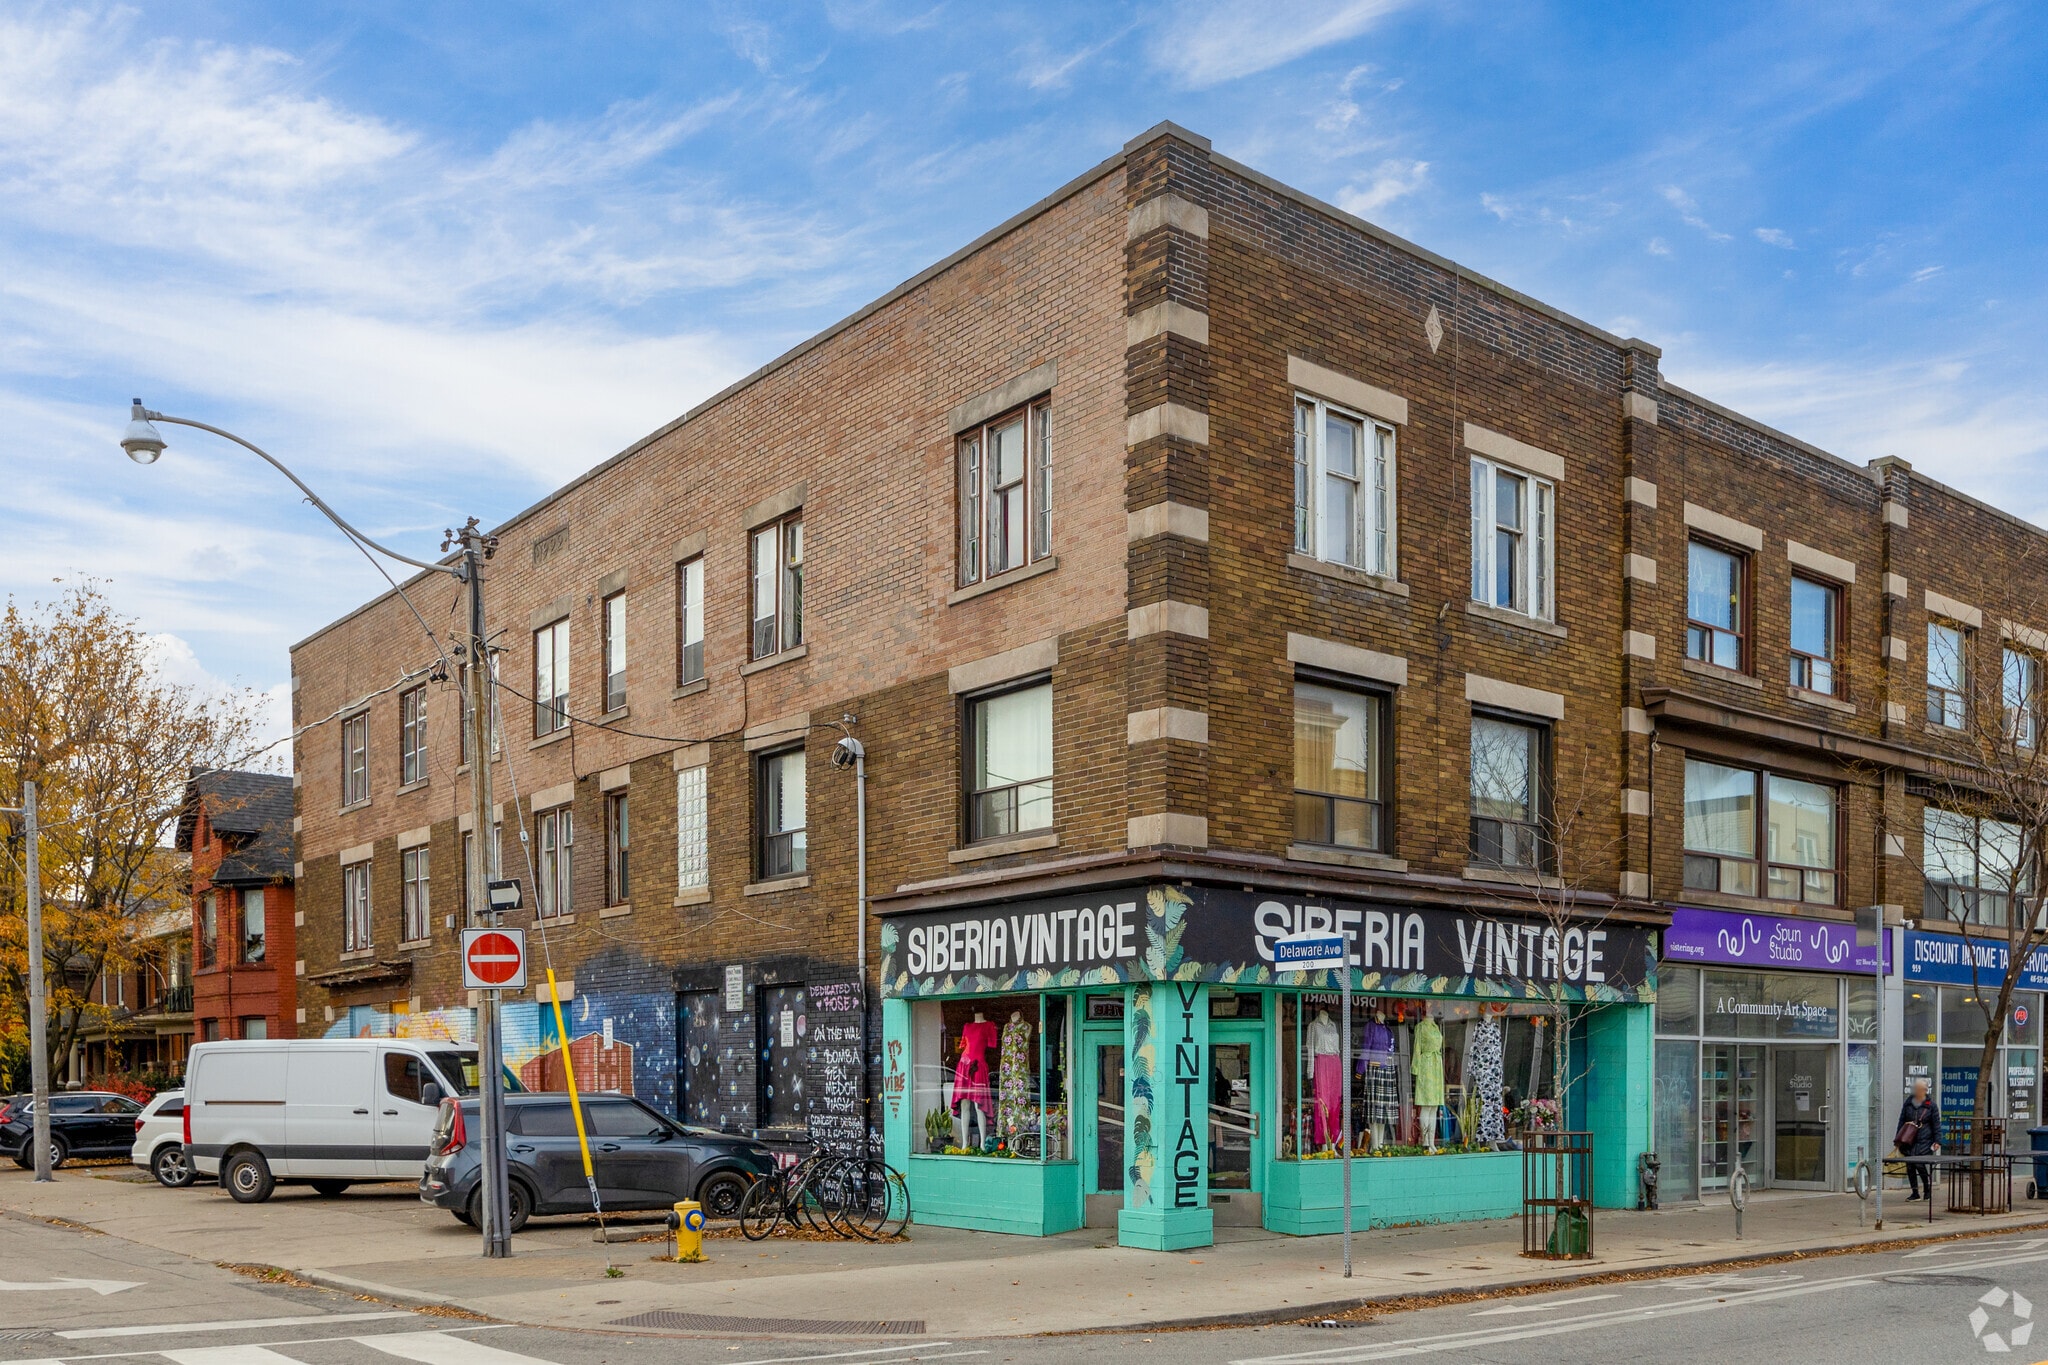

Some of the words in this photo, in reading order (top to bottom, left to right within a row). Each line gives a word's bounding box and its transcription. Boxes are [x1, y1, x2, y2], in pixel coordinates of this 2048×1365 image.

[908, 918, 1007, 975] SIBERIA
[1011, 902, 1136, 966] VINTAGE
[1771, 923, 1801, 944] Spun
[1280, 945, 1323, 958] Delaware
[1324, 944, 1341, 956] Av
[1456, 919, 1606, 982] VINTAGE
[1670, 942, 1704, 957] sistering.org
[1769, 941, 1802, 961] Studio
[1915, 939, 1958, 965] DISCOUNT
[1999, 949, 2009, 969] TA
[1912, 964, 1921, 973] 959
[810, 984, 851, 997] DEDICATED
[823, 995, 851, 1012] ROSE
[1716, 997, 1726, 1014] A
[1728, 996, 1783, 1020] Community
[1784, 999, 1800, 1016] Art
[1801, 1000, 1828, 1021] Space
[814, 1024, 826, 1041] ON
[826, 1025, 842, 1041] THE
[824, 1047, 860, 1065] BOMBA
[1908, 1065, 1928, 1075] INSTANT
[1941, 1071, 1962, 1080] stant
[1964, 1071, 1978, 1080] Tax
[2008, 1066, 2035, 1076] PROFESSIONAL
[1790, 1080, 1813, 1089] Studio
[1174, 982, 1200, 1208] VINTAGE
[1944, 1096, 1957, 1105] the
[1959, 1097, 1975, 1107] spo
